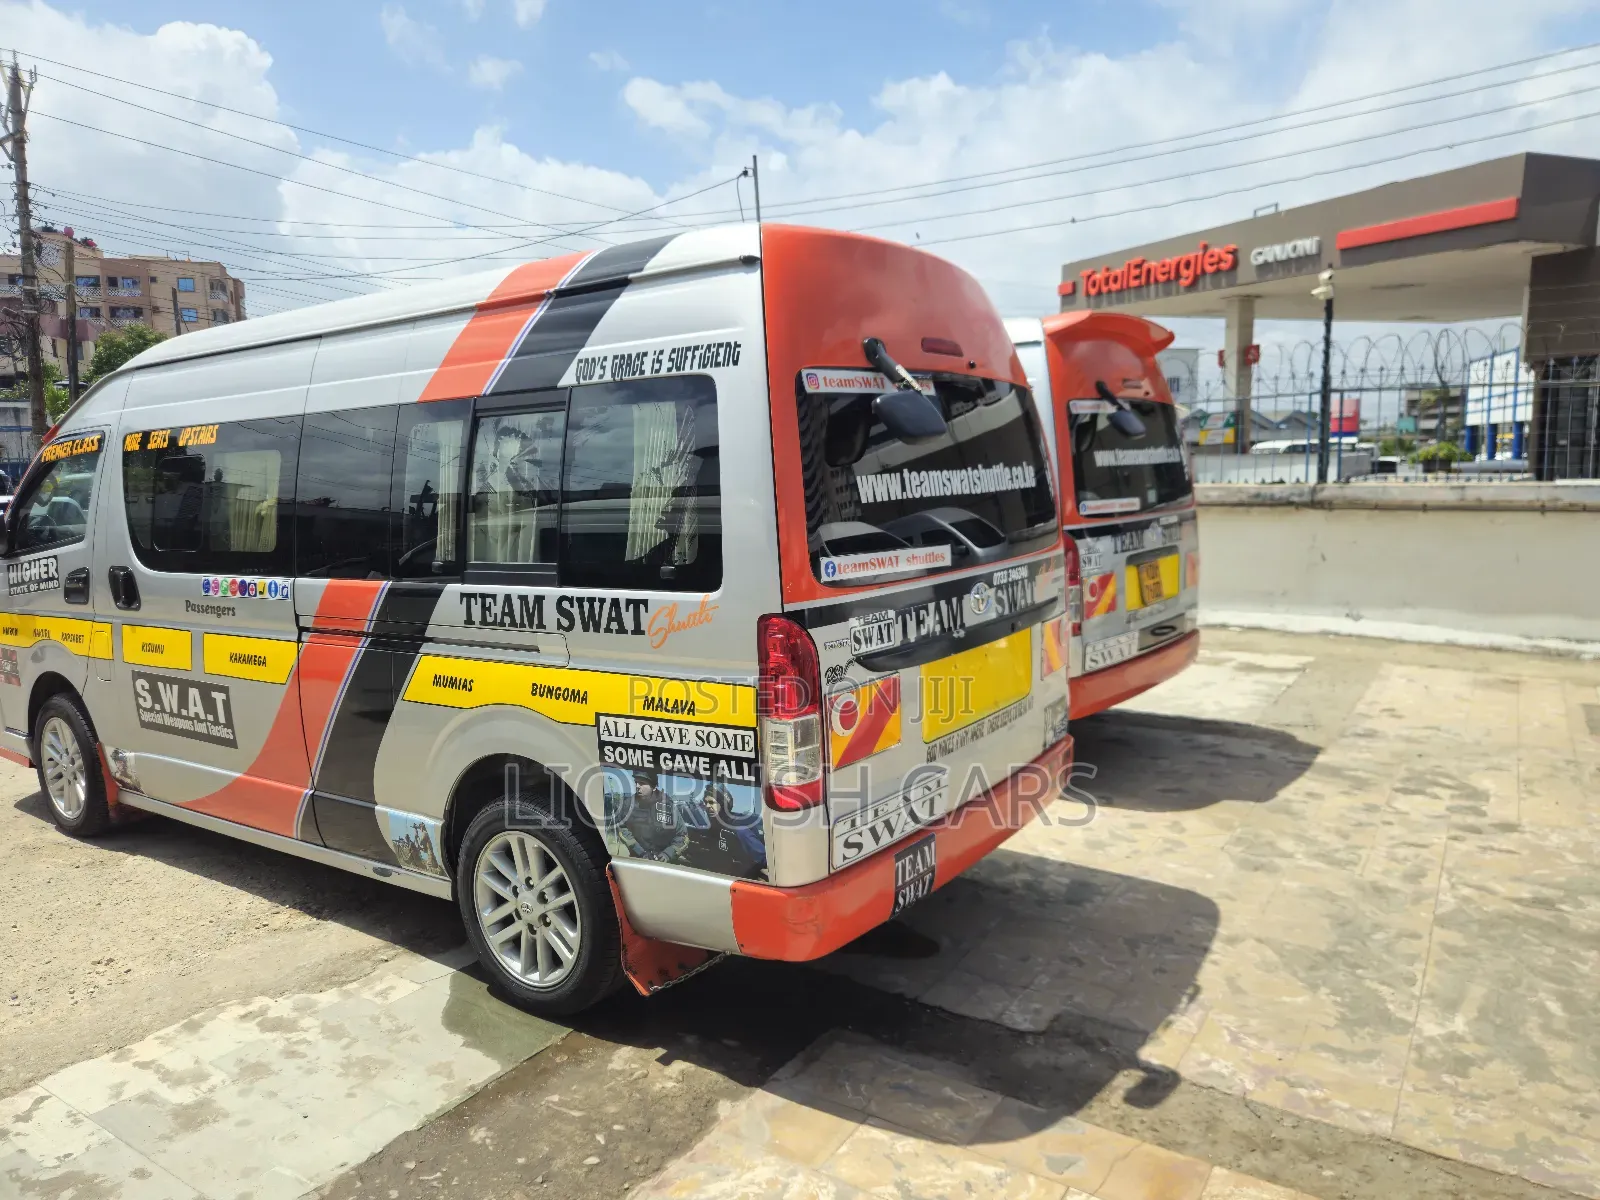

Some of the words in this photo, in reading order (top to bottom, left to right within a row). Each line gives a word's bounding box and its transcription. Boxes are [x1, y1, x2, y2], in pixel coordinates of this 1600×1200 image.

[1080, 241, 1237, 297] TotalEnergies
[610, 351, 648, 381] GRACE
[9, 557, 58, 585] HIGHER
[837, 557, 900, 575] teamSWAT
[906, 551, 946, 565] shuttles
[10, 585, 29, 594] STATE
[30, 583, 38, 591] OF
[40, 579, 59, 590] MIND
[185, 600, 236, 618] Passengers
[460, 592, 546, 630] TEAM
[555, 595, 649, 636] SWAT
[141, 641, 165, 654] KISUMU
[852, 622, 895, 652] SWAT
[229, 652, 267, 668] KAKAMEGA
[432, 674, 474, 693] MUMIAS
[530, 683, 589, 705] BUNGOMA
[135, 678, 227, 724] S.W.A.T
[642, 696, 697, 717] MALAVA
[601, 723, 637, 742] ALL
[640, 726, 690, 746] GAVE
[694, 731, 755, 753] SOME
[604, 745, 654, 769] SOME
[659, 752, 710, 776] GAVE
[716, 759, 756, 782] ALL
[844, 780, 942, 829] TEAM
[842, 793, 943, 862] SWAT
[895, 842, 936, 887] TEAM
[895, 873, 932, 914] SWAT
